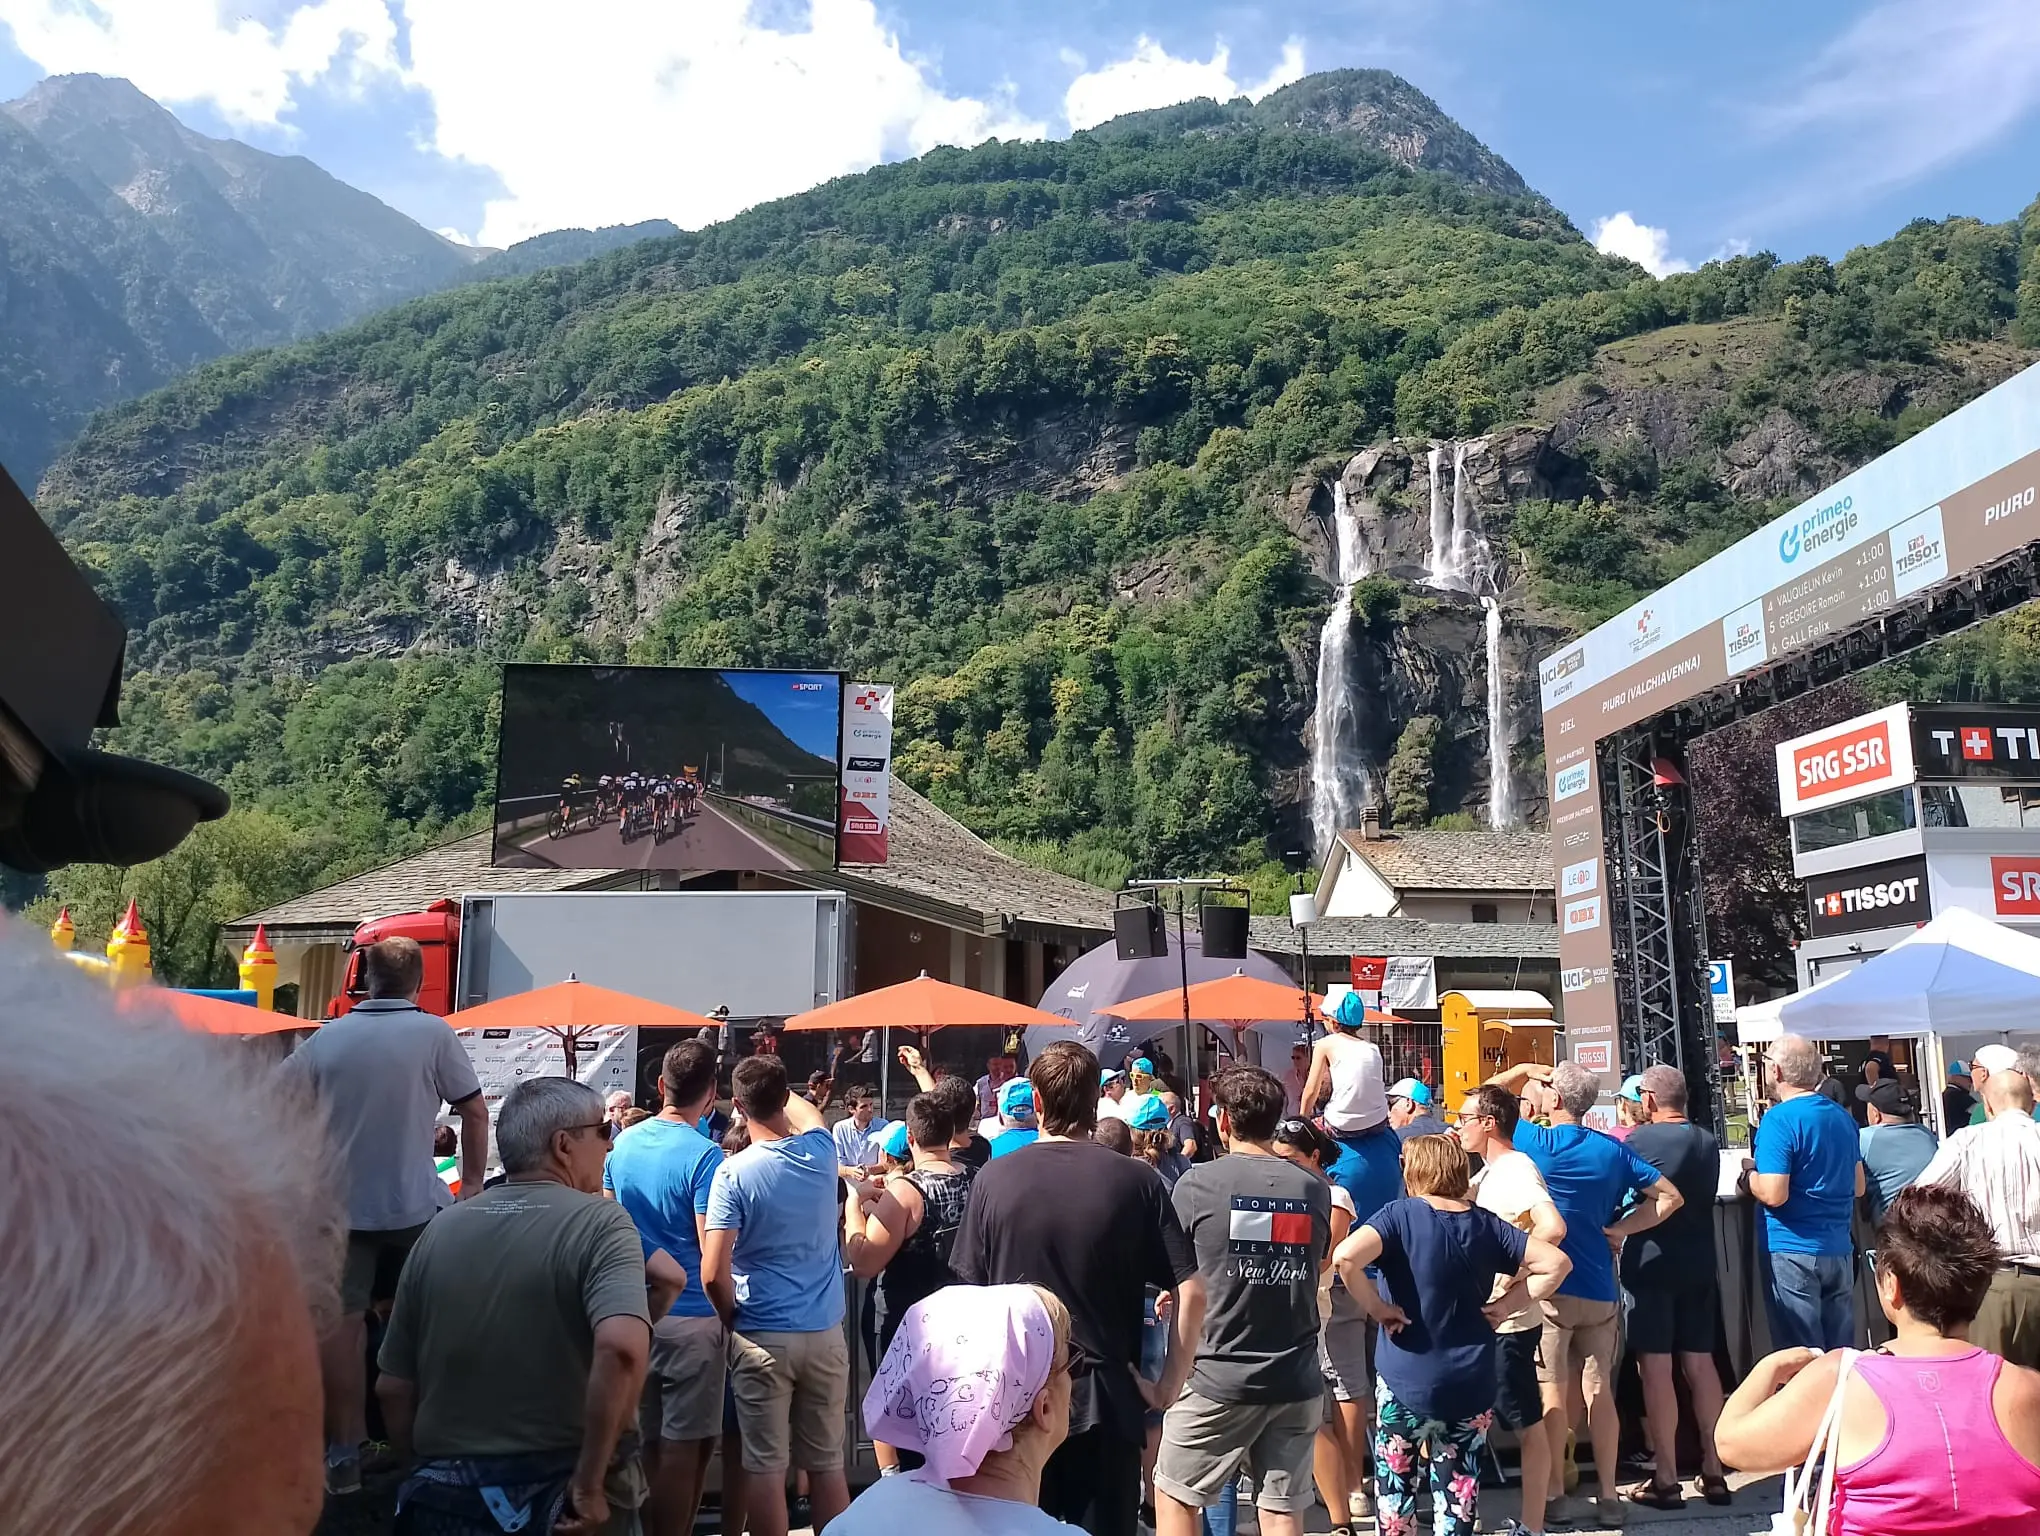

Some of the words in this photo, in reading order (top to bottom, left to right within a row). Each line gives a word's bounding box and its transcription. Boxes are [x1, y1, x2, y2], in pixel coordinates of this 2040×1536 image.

[1802, 495, 1853, 538] primeo
[1984, 487, 2035, 526] PIURO
[1803, 511, 1858, 553] energie
[1895, 540, 1940, 571] TISSOT
[1767, 601, 1773, 612] 4
[1776, 577, 1821, 607] VAUQUELIN
[1821, 566, 1843, 585] Kevin
[1856, 542, 1884, 567] +1:00
[1769, 622, 1775, 634] 5
[1779, 600, 1818, 628] GREGOIRE
[1818, 589, 1845, 608] Romain
[1858, 566, 1887, 590] +1:00
[1771, 643, 1777, 654] 6
[1781, 628, 1807, 650] GALL
[1807, 620, 1830, 638] Felix
[1861, 590, 1889, 612] +1:00
[1728, 630, 1760, 654] TISSOT
[799, 683, 824, 691] SPORT
[1541, 667, 1557, 686] UCI
[1602, 693, 1626, 714] PIURO
[1627, 653, 1701, 704] (VALCHIAVENNA)
[1560, 718, 1575, 735] ZIEL
[1798, 750, 1841, 788] SRG
[1841, 737, 1887, 777] SSR
[1841, 877, 1919, 914] TISSOT
[1563, 972, 1581, 988] UCI
[1579, 1052, 1592, 1064] SRG
[1592, 1051, 1606, 1063] SSR
[1585, 1112, 1609, 1131] Blick
[1236, 1199, 1309, 1211] TOMMY
[1235, 1242, 1305, 1255] JEANS
[1227, 1258, 1265, 1278] New
[1265, 1259, 1307, 1286] York
